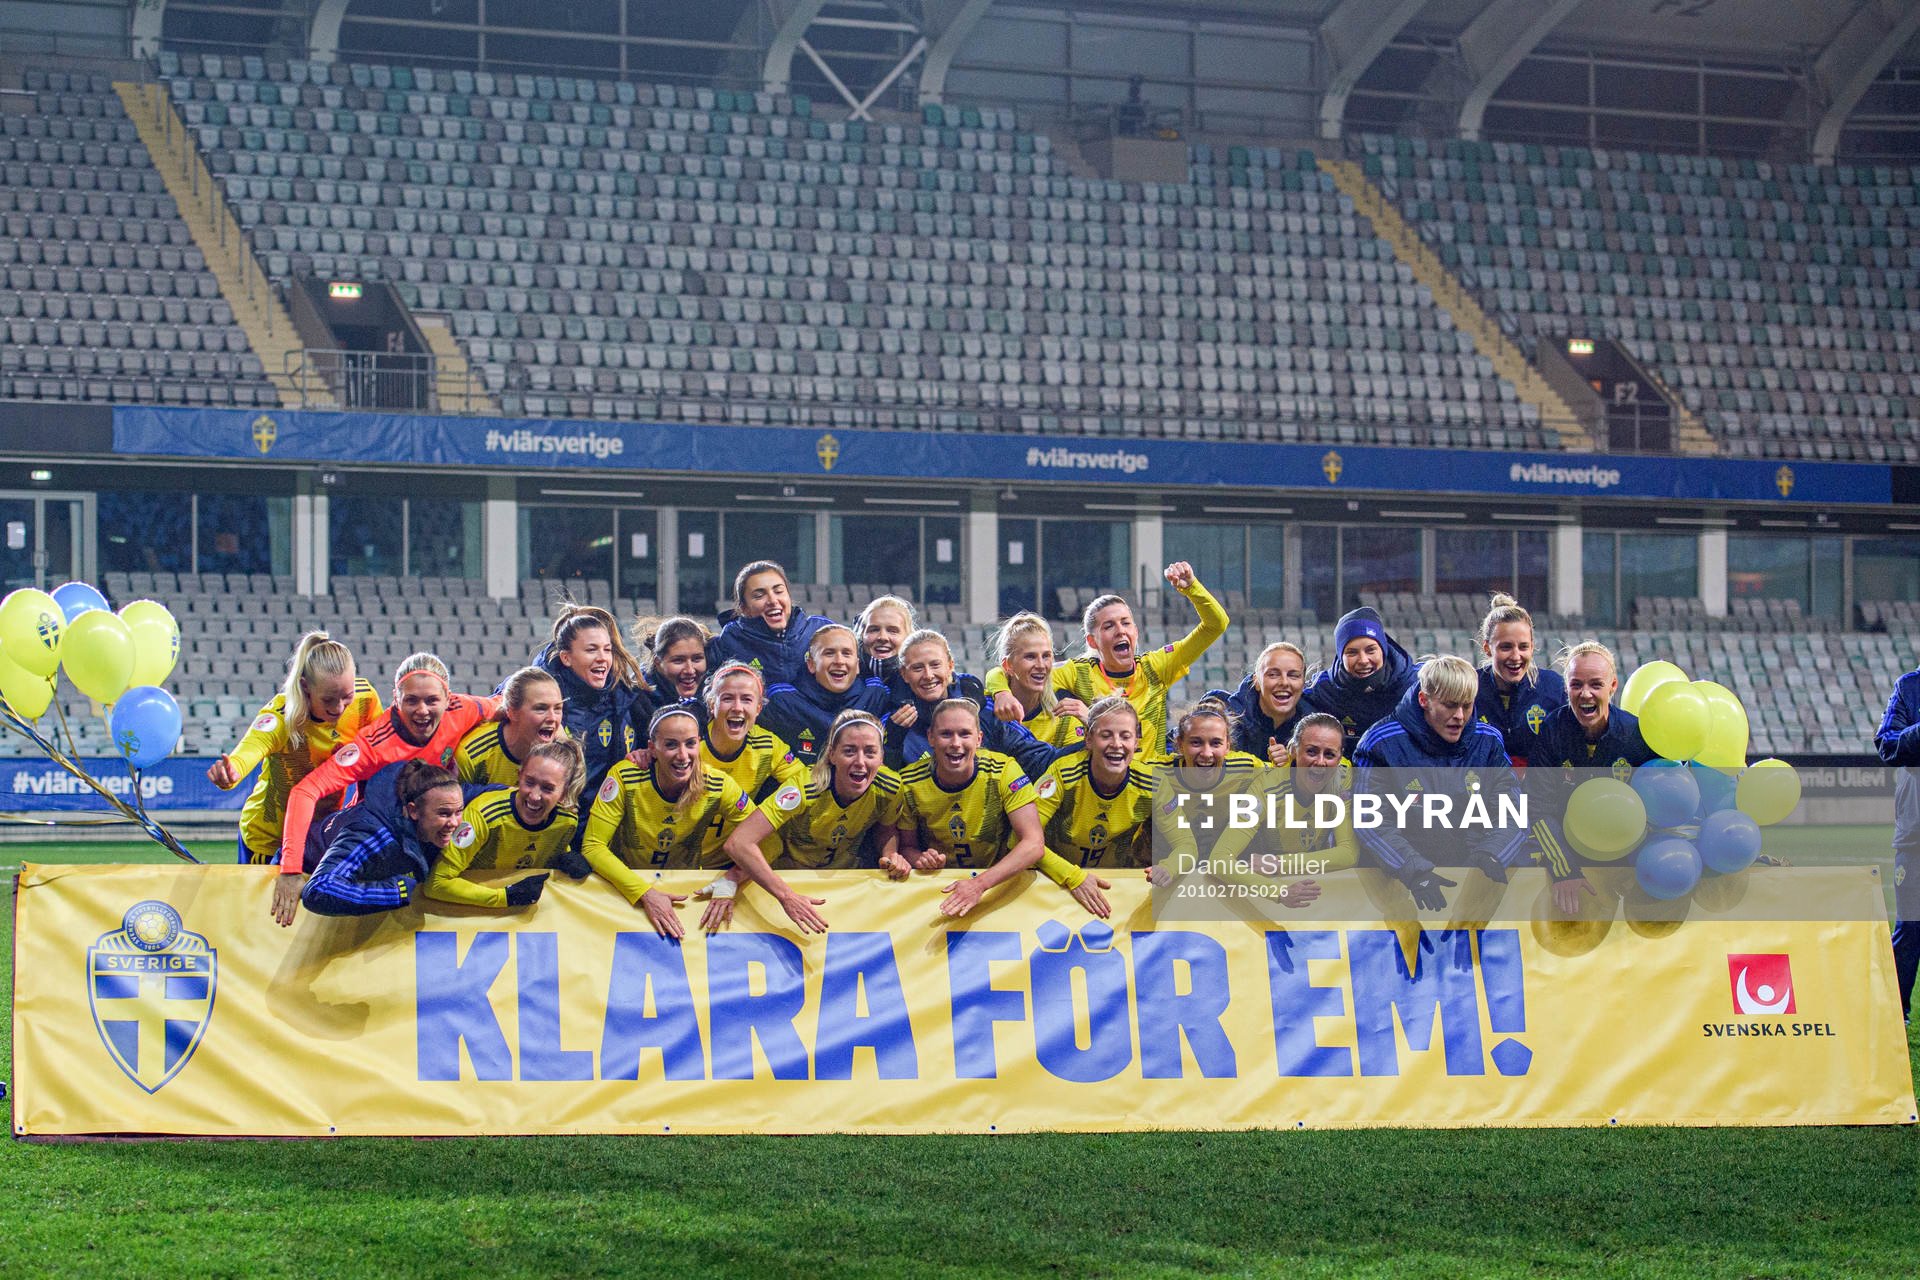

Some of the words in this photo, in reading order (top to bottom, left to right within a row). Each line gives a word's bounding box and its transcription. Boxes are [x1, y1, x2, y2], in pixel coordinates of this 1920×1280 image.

[1615, 382, 1638, 406] F2
[485, 429, 624, 458] #viärsverige
[1026, 447, 1149, 473] #viärsverige
[1510, 462, 1621, 488] #viärsverige
[1800, 768, 1835, 788] mla
[1838, 767, 1886, 788] Ullevi
[954, 844, 976, 869] 2
[107, 957, 197, 970] SVERIGE
[415, 931, 919, 1081] KLARA
[946, 918, 1238, 1083] FÖR
[1265, 928, 1534, 1078] EM!
[1702, 1023, 1787, 1037] SVENSKA
[1791, 1023, 1836, 1037] SPEL
